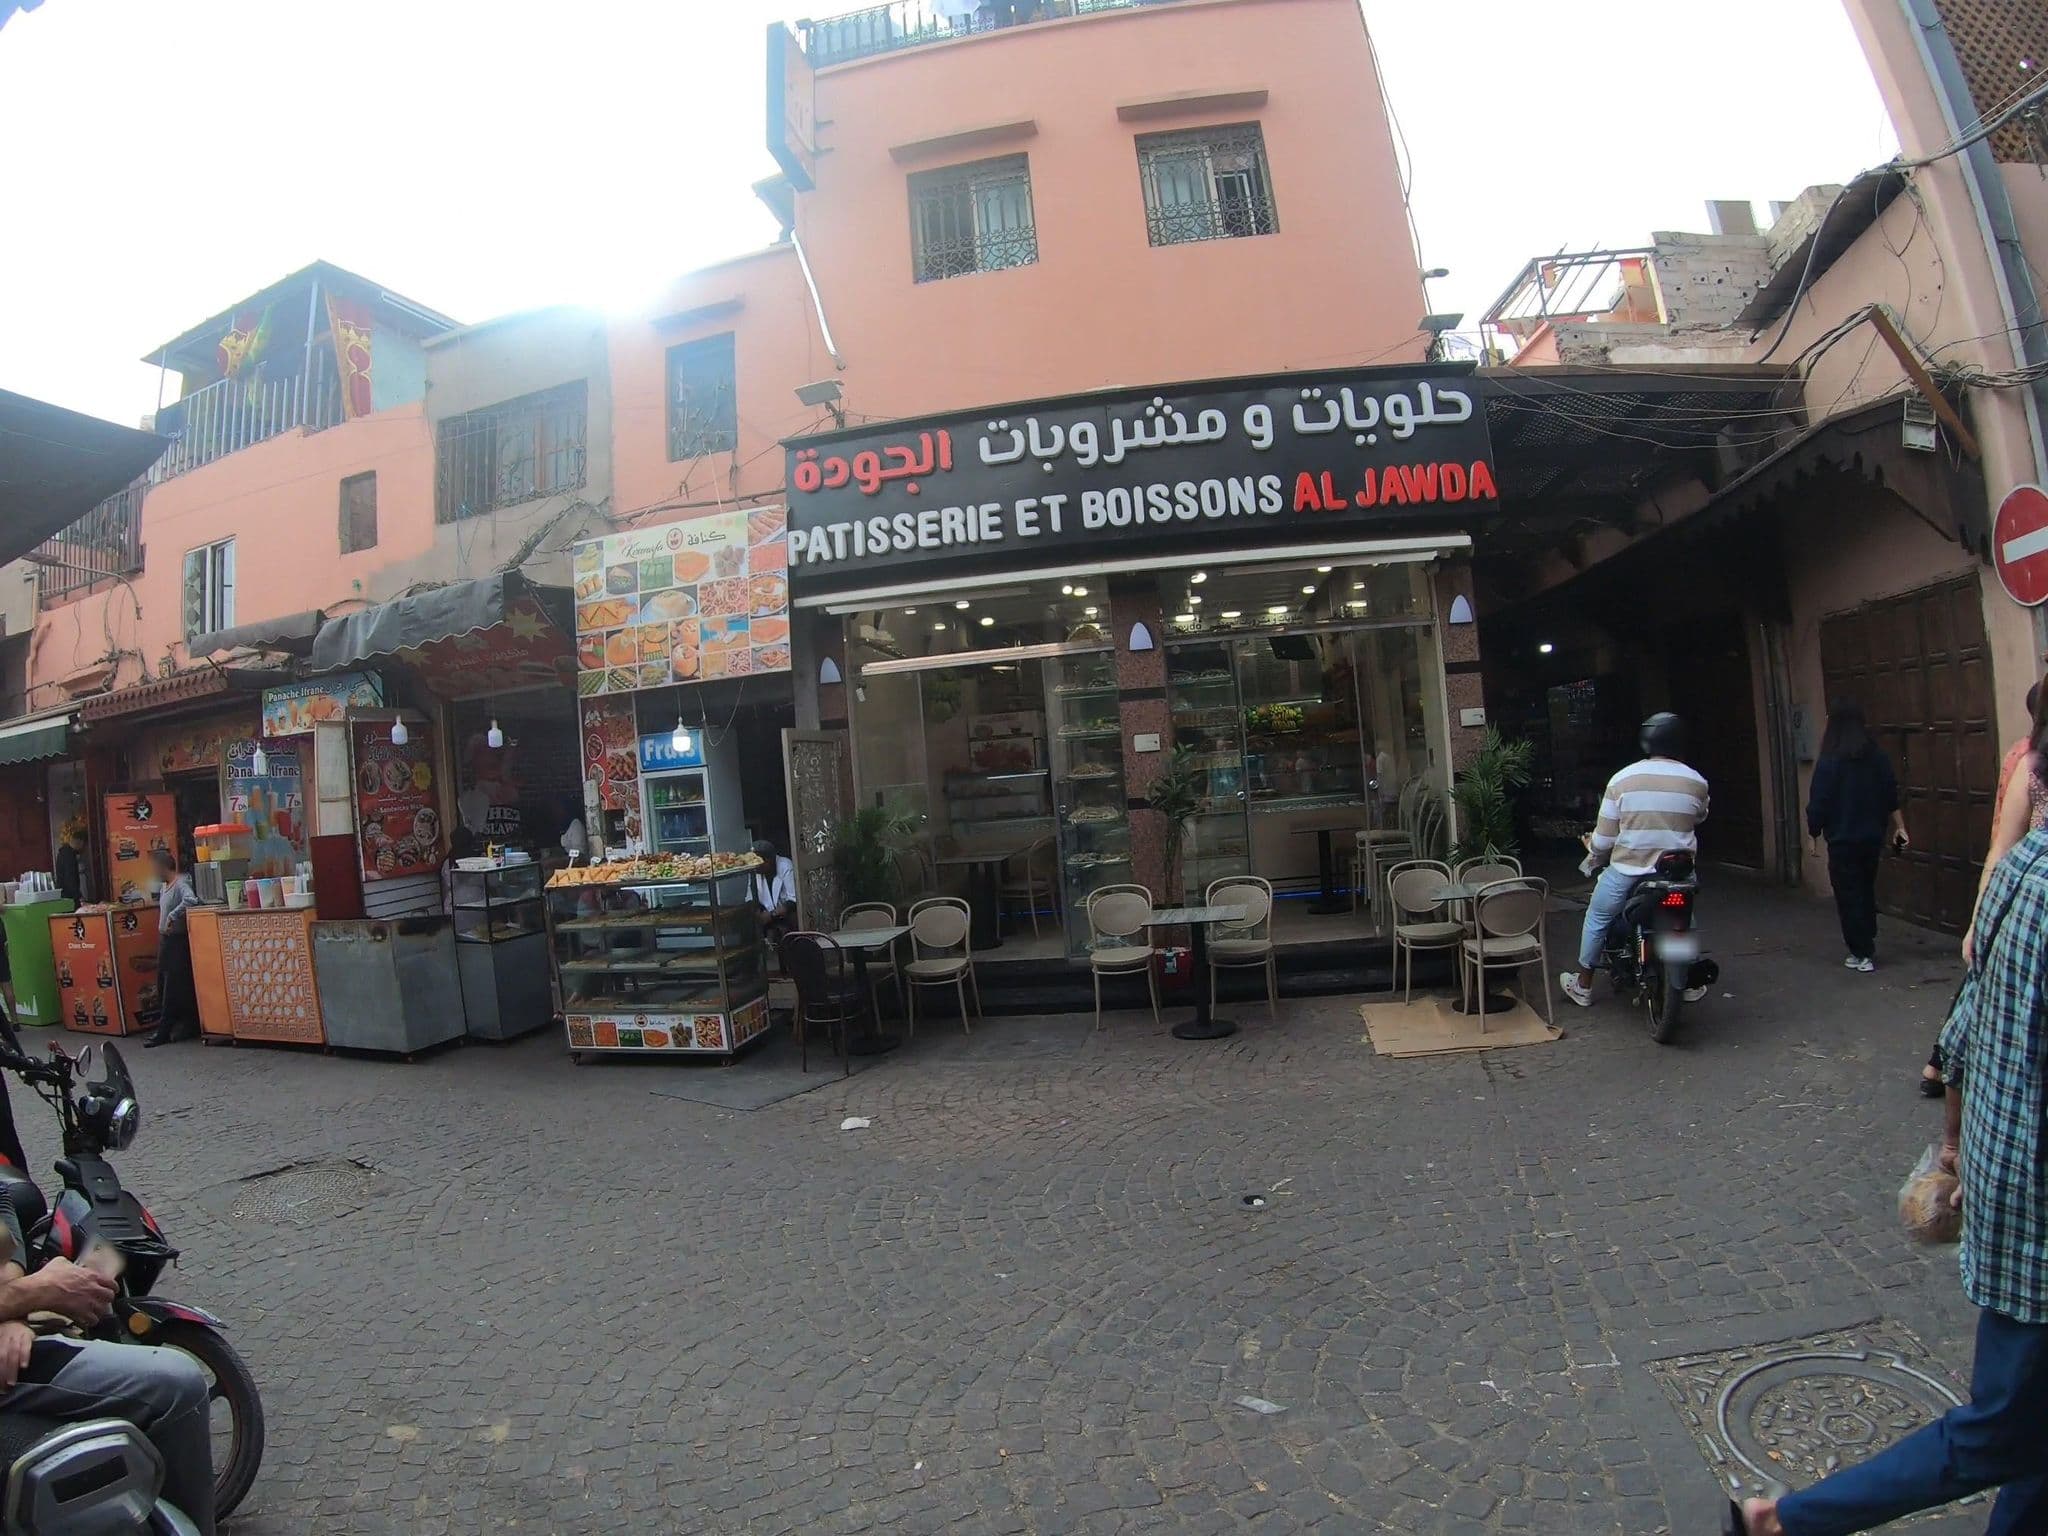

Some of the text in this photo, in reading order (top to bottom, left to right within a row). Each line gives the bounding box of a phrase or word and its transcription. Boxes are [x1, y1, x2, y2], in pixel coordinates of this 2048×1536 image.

[794, 381, 1474, 494] حلويات و مشروبات الجودة
[788, 460, 1498, 567] PATISSERIE ET BOISSONS AL JAWDA
[268, 690, 300, 705] Panache
